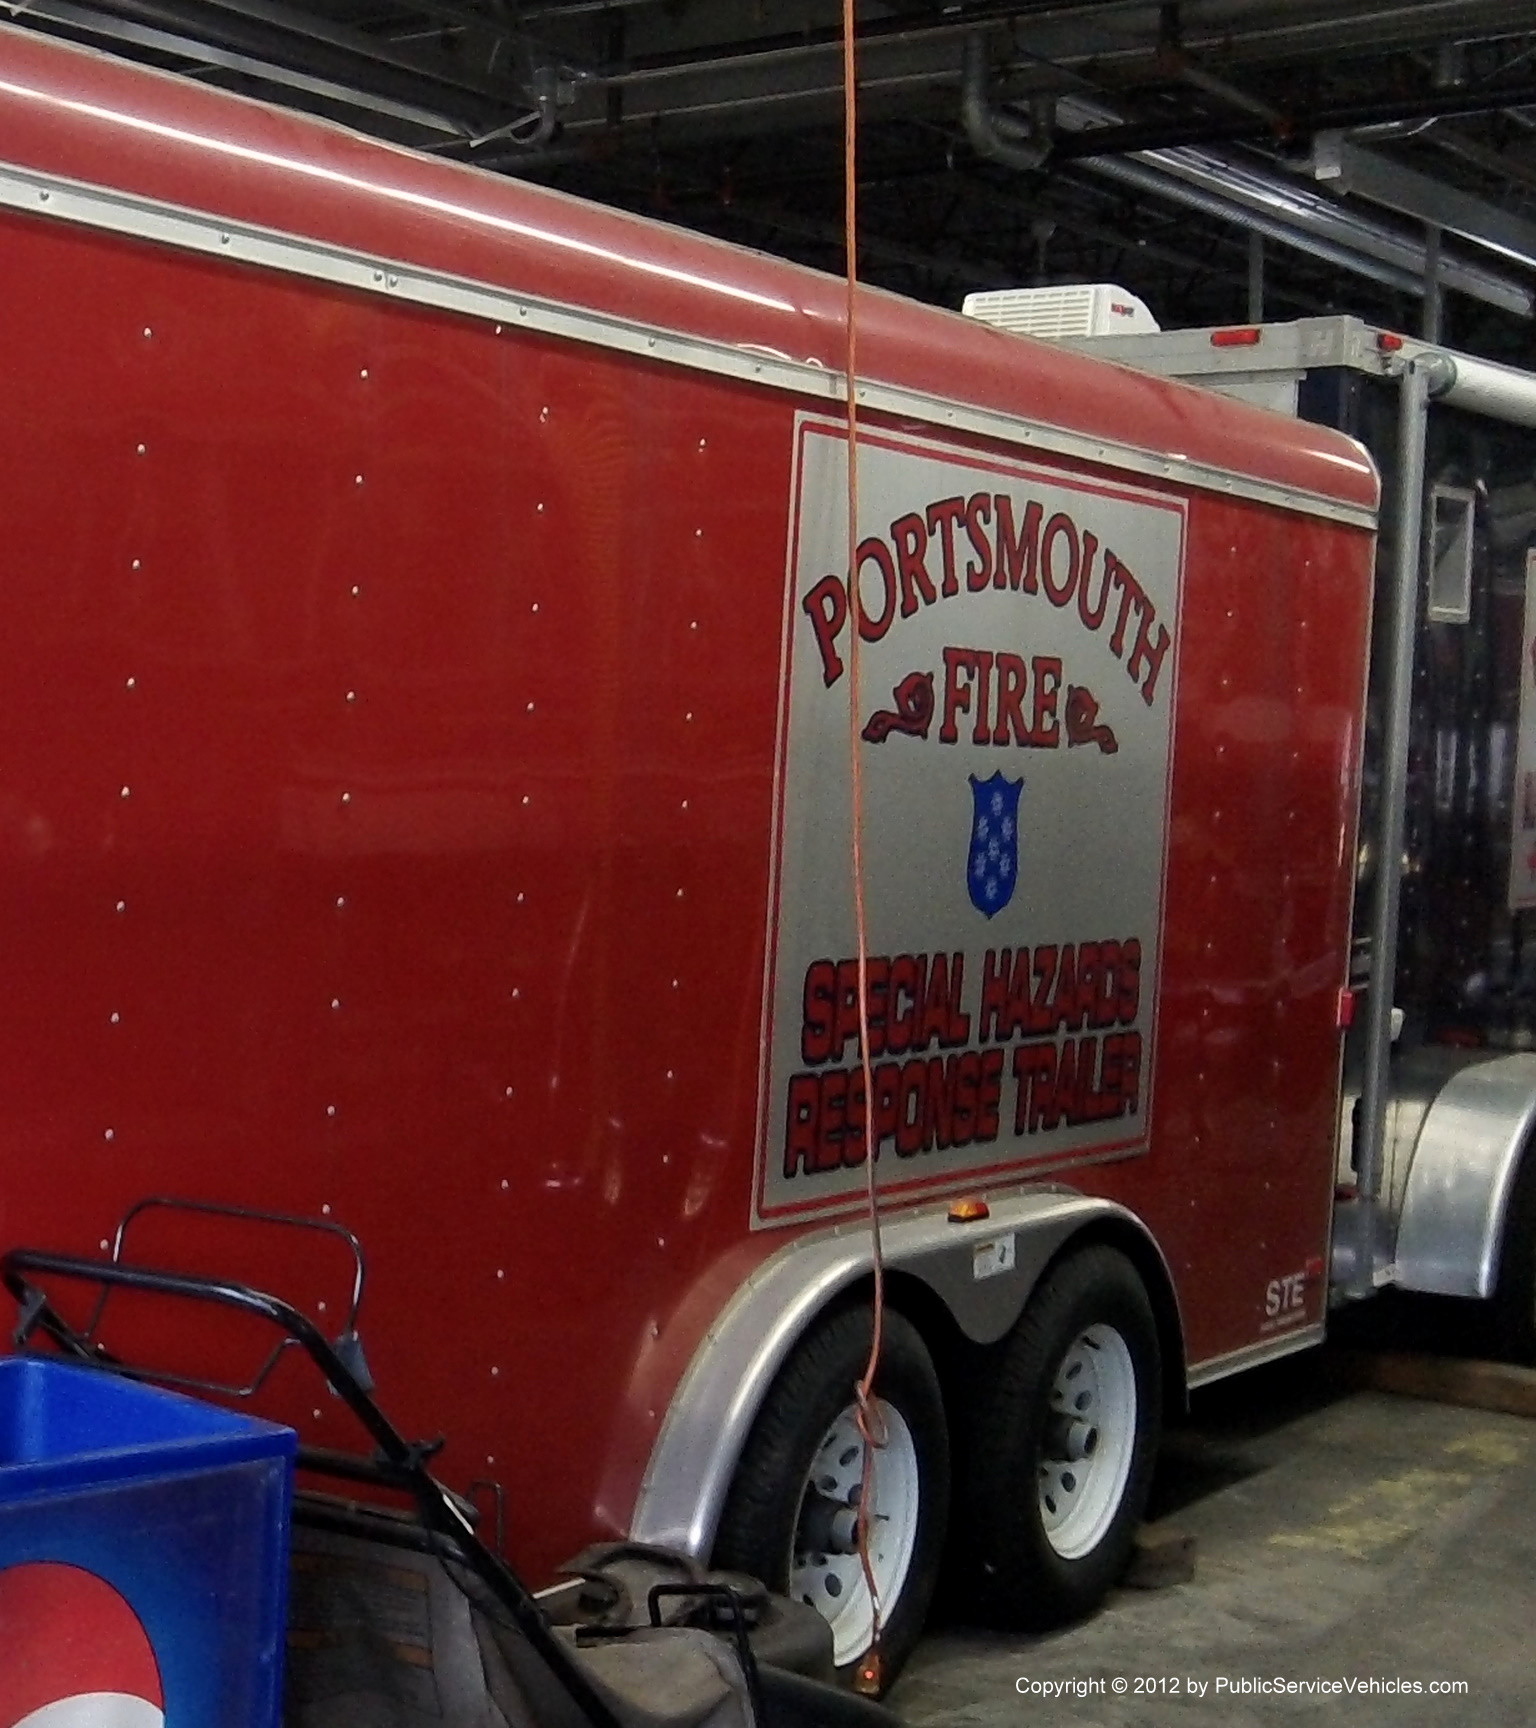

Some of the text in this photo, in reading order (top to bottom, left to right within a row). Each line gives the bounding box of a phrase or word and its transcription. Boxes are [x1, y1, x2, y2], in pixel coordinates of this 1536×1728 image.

[801, 491, 1172, 707] PORTSMOUTH
[938, 645, 1063, 749] FIRE
[801, 936, 1143, 1066] SPECIAL HAZARDS
[782, 1030, 1144, 1180] RESPONSE TRAILER
[1265, 1271, 1306, 1318] STE
